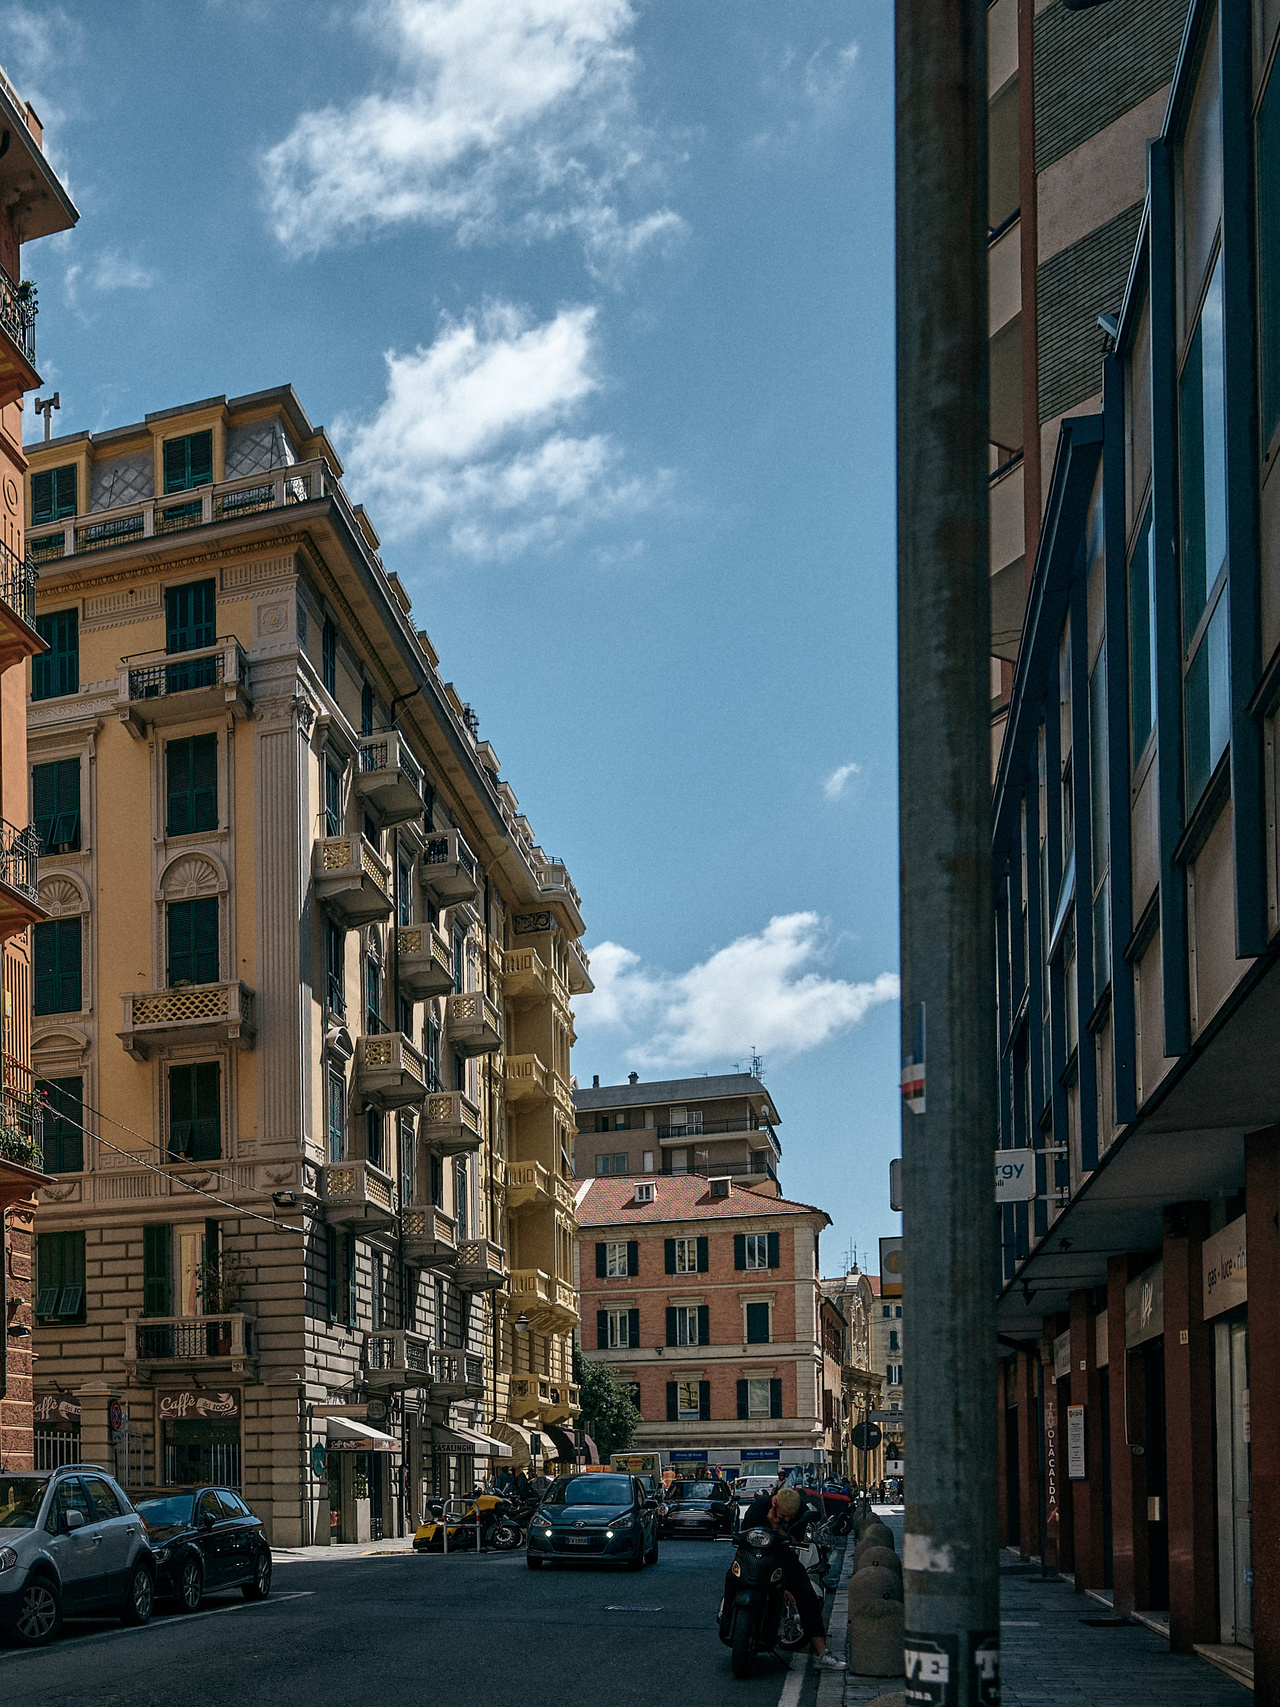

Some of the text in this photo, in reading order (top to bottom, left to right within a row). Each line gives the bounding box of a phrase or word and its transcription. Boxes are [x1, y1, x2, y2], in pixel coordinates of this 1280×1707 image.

[995, 1163, 1024, 1179] rgy
[1208, 1246, 1247, 1294] gas luce rin
[32, 1396, 58, 1420] affè
[161, 1392, 196, 1416] Caffè
[433, 1444, 474, 1452] CASALINGHI
[1047, 1402, 1056, 1504] TAVOLA CALDA
